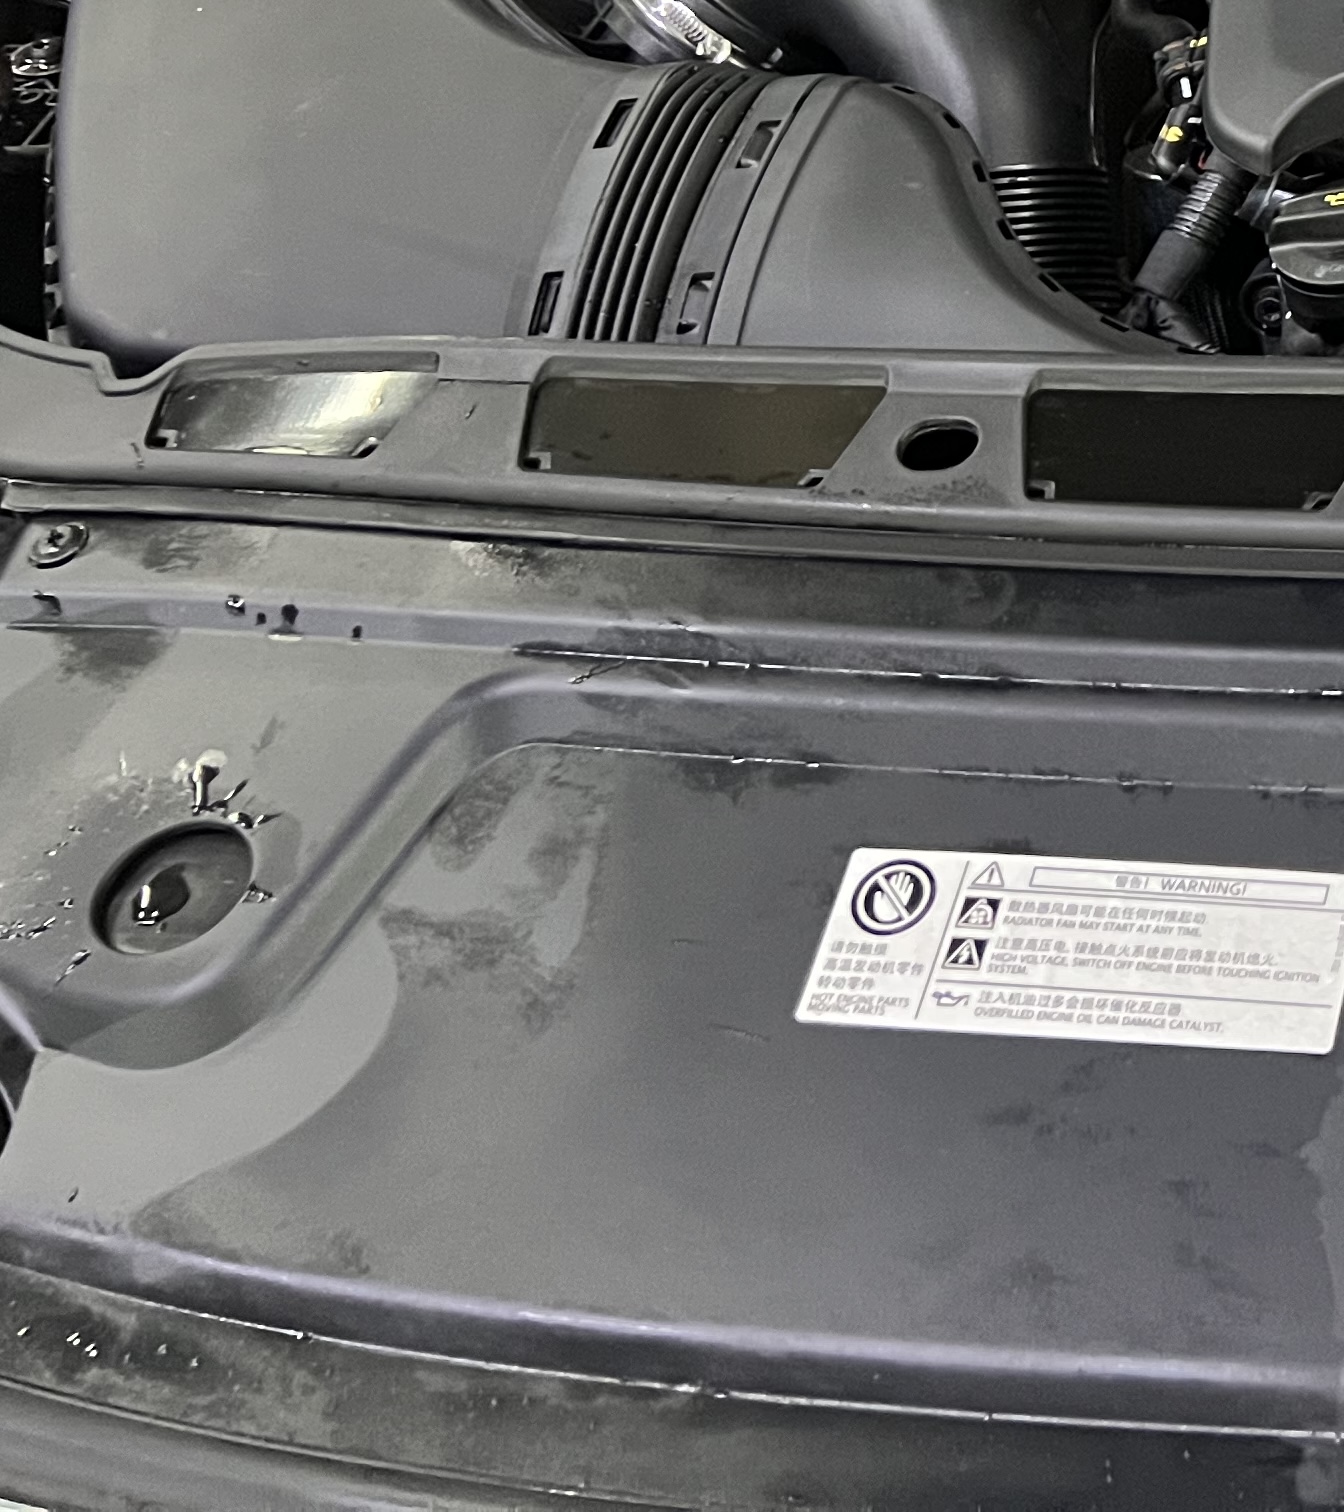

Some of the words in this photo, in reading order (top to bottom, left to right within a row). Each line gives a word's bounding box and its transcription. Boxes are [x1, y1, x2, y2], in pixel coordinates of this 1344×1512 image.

[1161, 878, 1248, 896] WARNING!
[1003, 915, 1054, 927] RADIATOR
[1056, 917, 1076, 928] FAN
[1079, 918, 1101, 930] MAY
[1103, 920, 1135, 932] START
[1137, 922, 1151, 933] AT
[1152, 923, 1175, 936] ANY
[1072, 957, 1112, 969] SWITCH
[1113, 959, 1134, 970] OFF
[1216, 966, 1271, 979] TOUCHING
[1096, 1013, 1119, 1025] CAN
